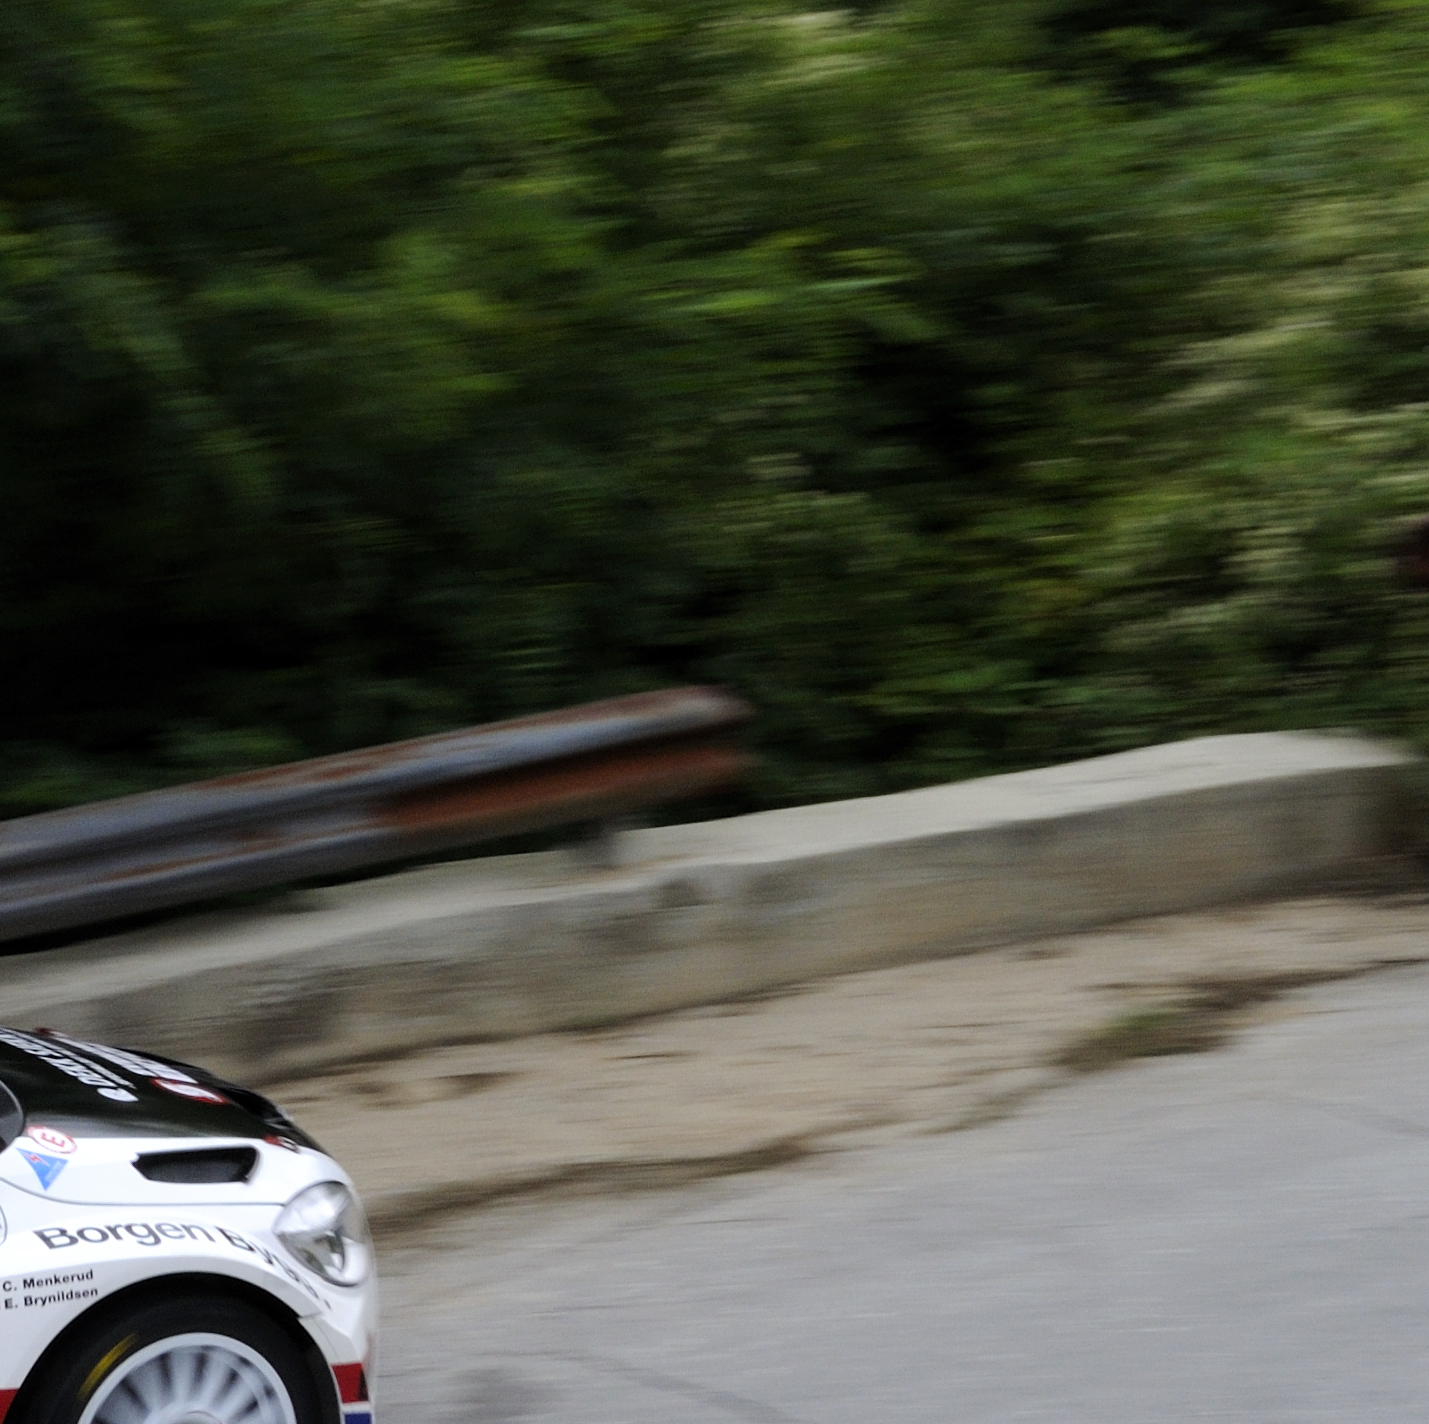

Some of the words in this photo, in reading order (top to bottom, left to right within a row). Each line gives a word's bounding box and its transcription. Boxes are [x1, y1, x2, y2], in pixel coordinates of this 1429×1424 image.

[33, 1222, 217, 1250] Borgen
[2, 1280, 18, 1292] C.
[22, 1269, 94, 1290] Menkerud
[4, 1298, 19, 1310] E.
[24, 1287, 98, 1308] Brynildsen
